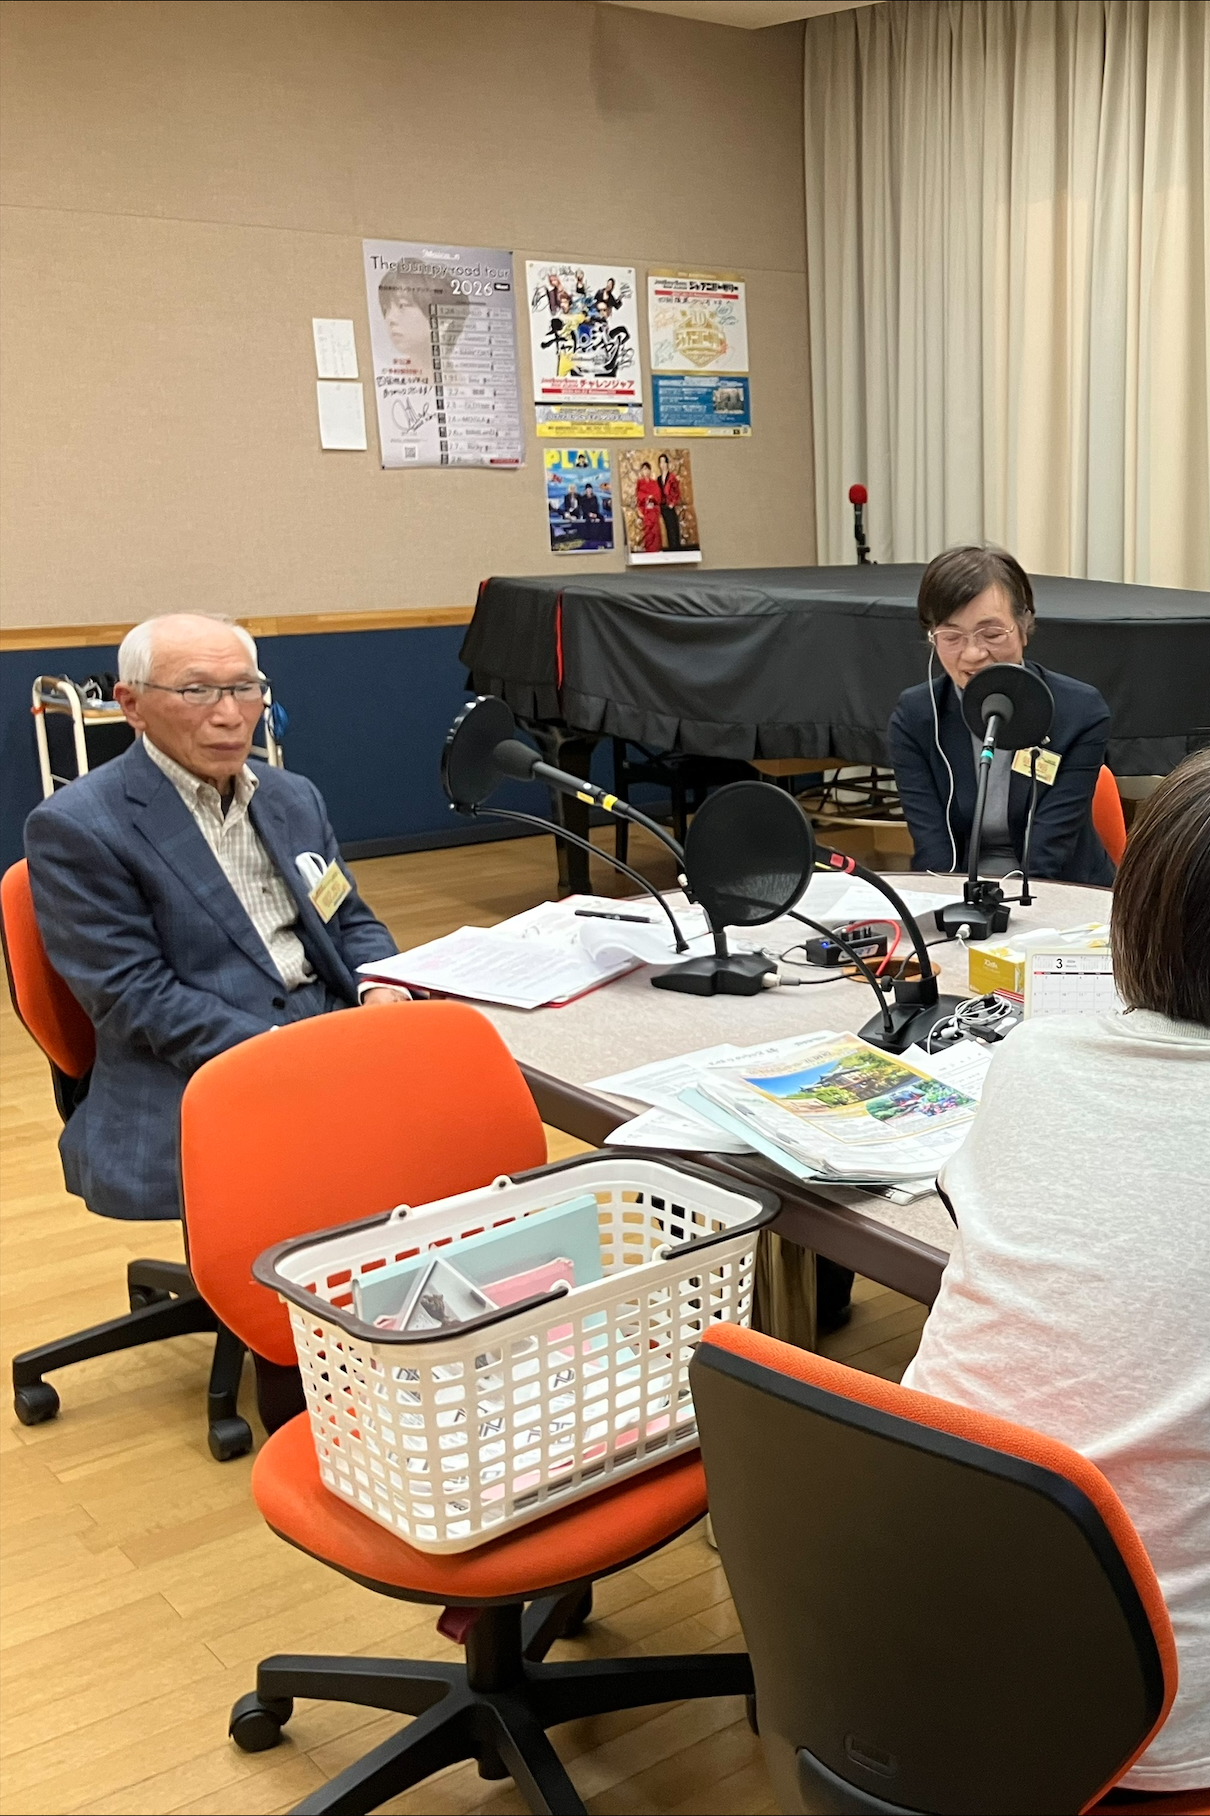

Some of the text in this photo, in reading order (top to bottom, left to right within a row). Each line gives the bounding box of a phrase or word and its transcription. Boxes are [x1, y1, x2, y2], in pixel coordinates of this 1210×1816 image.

[370, 256, 510, 279] The bumpy road tour
[450, 279, 494, 297] 2026
[580, 380, 635, 389] チャレンジャア
[545, 449, 610, 468] PLAY!
[1056, 958, 1063, 969] 3
